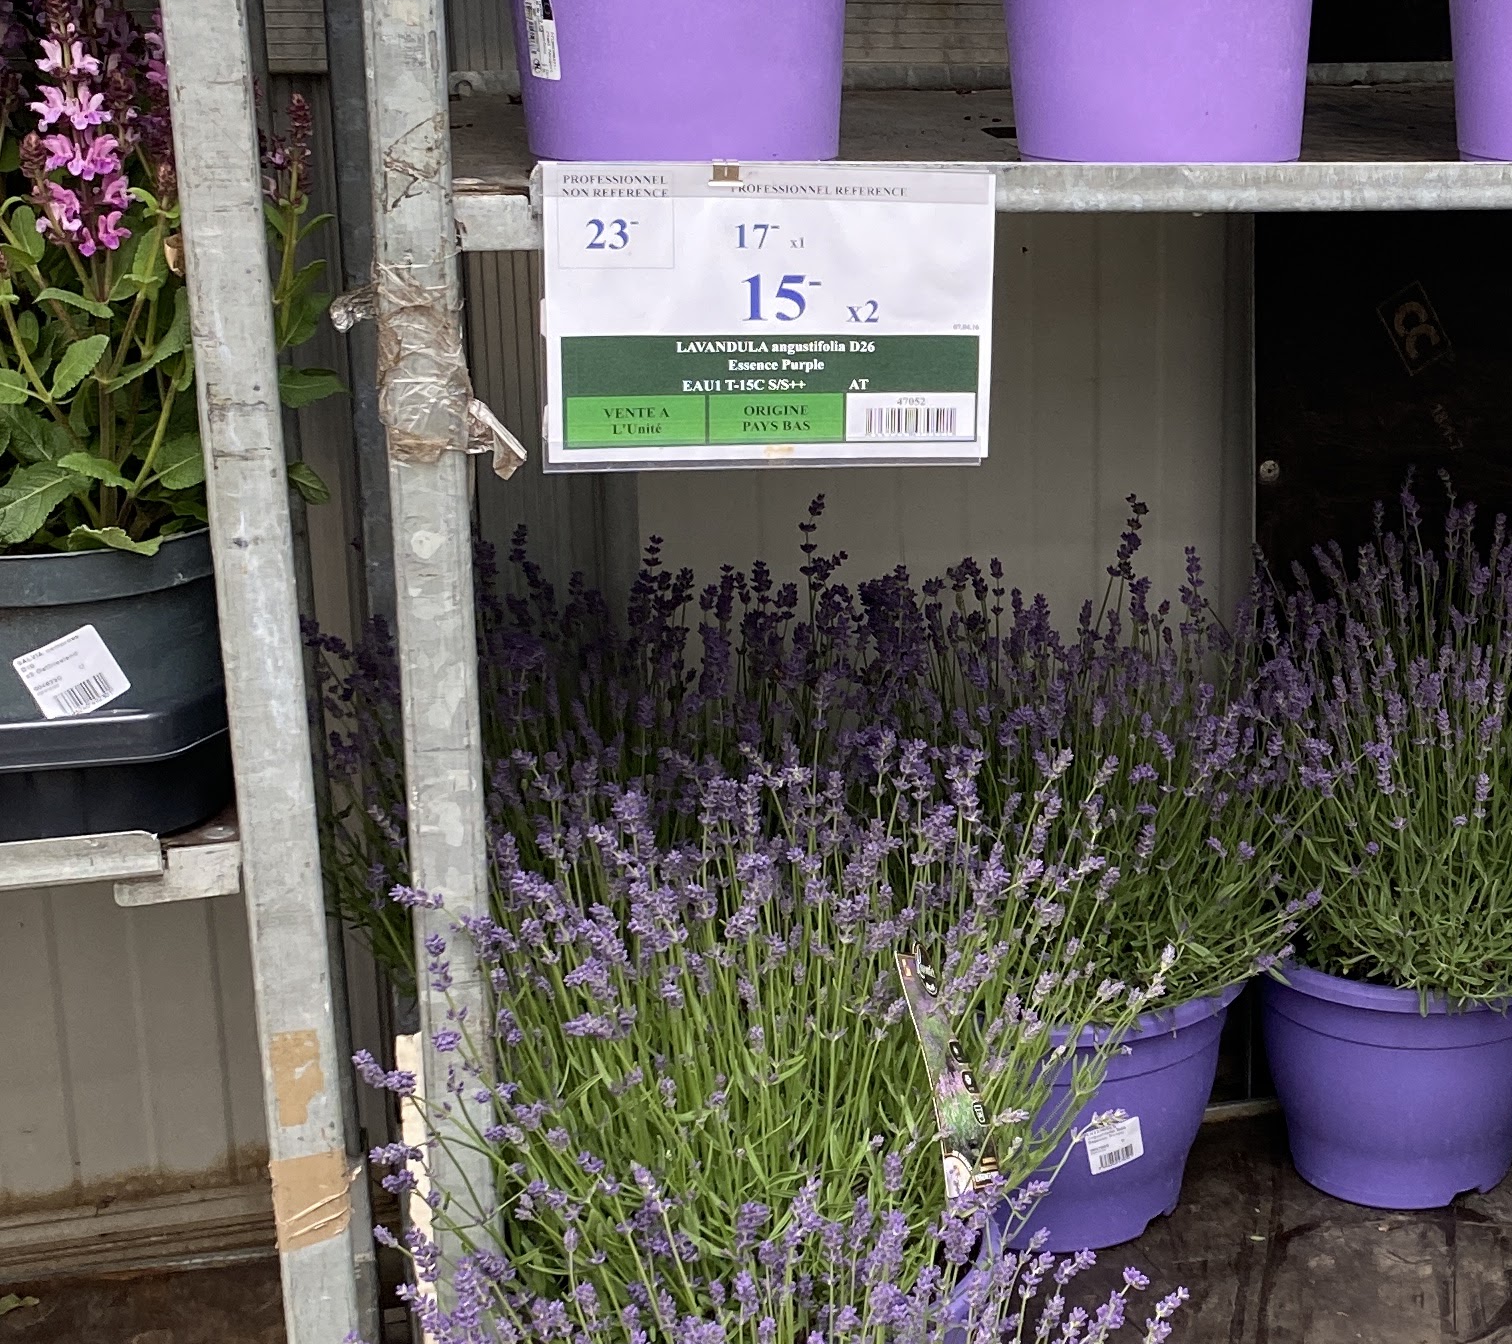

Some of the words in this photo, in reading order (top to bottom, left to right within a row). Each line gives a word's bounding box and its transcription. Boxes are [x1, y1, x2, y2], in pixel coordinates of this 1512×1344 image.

[563, 174, 668, 185] PROFESSIONNEL
[562, 188, 591, 198] NON
[593, 188, 669, 198] REFERENCE
[835, 186, 908, 198] REFERENCE
[846, 299, 879, 323] x2
[676, 341, 769, 353] LAVANDULA
[771, 341, 846, 355] angustifolia
[849, 341, 876, 353] D26
[728, 359, 779, 371] Essence
[782, 358, 825, 373] Purple
[725, 379, 765, 391] T-15C
[768, 378, 807, 391] S/S++
[848, 379, 870, 390] AT
[897, 397, 926, 406] 47052
[603, 407, 656, 419] VENTE
[660, 407, 670, 418] A
[744, 405, 809, 416] ORIGINE
[612, 423, 662, 435] L'Unité
[742, 420, 778, 432] PAYS
[782, 419, 811, 431] BAS
